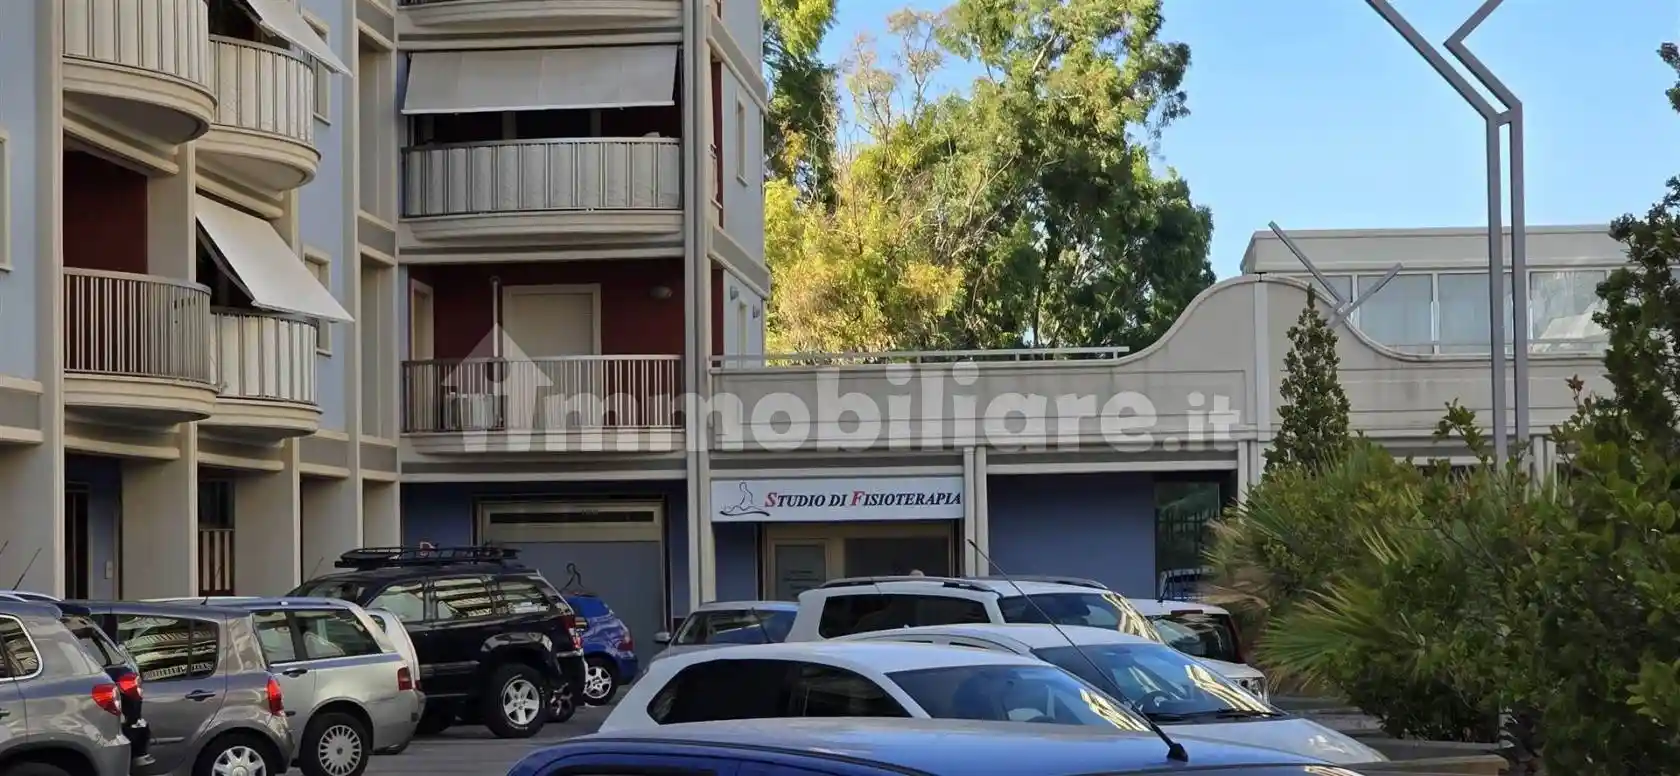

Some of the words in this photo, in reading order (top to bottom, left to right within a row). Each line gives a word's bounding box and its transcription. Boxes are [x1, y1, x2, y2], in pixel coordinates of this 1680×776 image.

[765, 492, 826, 508] STUDIO
[828, 494, 847, 507] DI
[851, 491, 962, 507] FISIOTERAPIA
